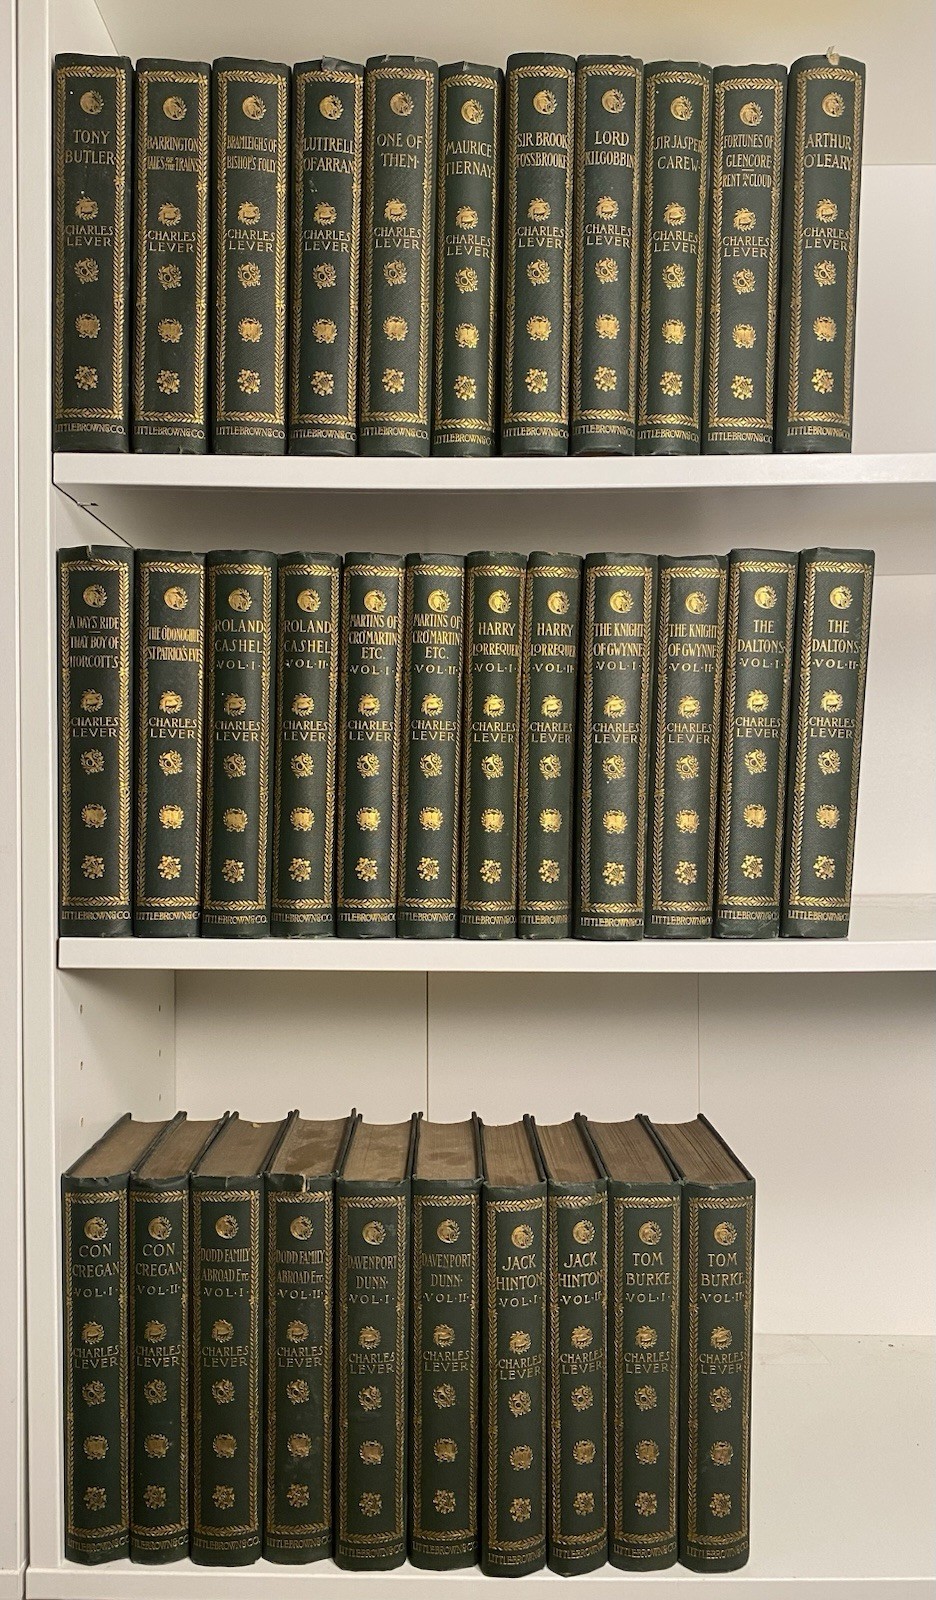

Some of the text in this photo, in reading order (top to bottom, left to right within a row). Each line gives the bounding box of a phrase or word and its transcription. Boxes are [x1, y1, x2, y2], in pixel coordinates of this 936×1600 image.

[73, 130, 110, 144] TONY
[377, 132, 423, 150] ONE OF
[517, 132, 568, 150] SIR BROOK
[594, 130, 630, 147] LORD
[654, 135, 671, 150] SIR
[723, 133, 774, 149] FORTUNES OF
[805, 132, 852, 150] ARTHUR
[268, 140, 278, 153] OF
[446, 140, 491, 158] MAURICE
[304, 157, 316, 171] OF
[722, 173, 771, 188] RENT CLOUD
[65, 225, 113, 236] CHARLES
[147, 230, 196, 242] CHARLES
[303, 230, 350, 242] CHARLES
[374, 226, 421, 239] CHARLES
[517, 226, 564, 238] CHARLES
[585, 224, 631, 237] CHARLES
[652, 230, 698, 244] CHARLES
[803, 227, 849, 240] CHARLES
[67, 237, 111, 247] LEVER
[149, 242, 194, 253] LEVER
[304, 241, 349, 253] LEVER
[375, 238, 420, 250] LEVER
[518, 237, 563, 249] LEVER
[586, 235, 631, 249] LEVER
[654, 241, 697, 255] LEVER
[805, 238, 848, 251] LEVER
[70, 616, 76, 629] A
[100, 616, 120, 630] RIDE
[214, 619, 264, 634] ROLAND
[284, 619, 331, 634] ROLAND
[350, 614, 399, 629] MARTINS OF
[413, 614, 461, 629] MARTINS OF
[753, 619, 775, 634] THE
[828, 619, 850, 634] THE
[149, 627, 161, 640] THE
[478, 622, 516, 637] HARRY
[537, 622, 574, 637] HARRY
[594, 623, 644, 637] THE KNIGHT
[670, 623, 718, 639] THE KNIGHT
[70, 635, 120, 650] THAT BOY OF
[214, 639, 263, 654] CASHEL
[284, 639, 331, 654] CASHEL
[593, 642, 643, 657] OF GWYNNE
[189, 648, 200, 662] EVE
[361, 647, 386, 659] ETC.
[425, 647, 449, 660] ETC.
[668, 643, 717, 658] OF GWYNNE
[71, 716, 119, 727] CHARLES
[149, 717, 197, 728] CHARLES
[283, 720, 328, 731] CHARLES
[347, 720, 394, 731] CHARLES
[472, 722, 516, 732] CHARLES
[593, 723, 640, 733] CHARLES
[667, 723, 712, 733] CHARLES
[736, 717, 780, 728] CHARLES
[810, 717, 855, 728] CHARLES
[72, 728, 118, 738] LEVER
[150, 728, 196, 739] LEVER
[284, 732, 327, 742] LEVER
[350, 731, 392, 741] LEVER
[474, 732, 514, 743] LEVER
[594, 733, 638, 744] LEVER
[668, 733, 711, 744] LEVER
[737, 728, 779, 739] LEVER
[810, 727, 853, 739] LEVER
[79, 1243, 112, 1258] CON
[143, 1243, 175, 1257] CON
[201, 1248, 250, 1262] DODD FAMILY
[299, 1250, 325, 1264] FAMILY
[347, 1255, 397, 1270] DAVENPORT
[421, 1253, 471, 1268] DAVENPORT
[502, 1253, 537, 1271] JACK
[563, 1251, 597, 1268] JACK
[632, 1252, 663, 1267] TOM
[708, 1252, 737, 1267] TOM
[72, 1261, 120, 1278] CREGAN
[135, 1261, 182, 1277] CREGAN
[202, 1269, 235, 1282] ABROAD
[278, 1270, 310, 1284] ABROAD
[496, 1272, 543, 1291] HINTON
[558, 1270, 603, 1288] HINTON
[626, 1272, 671, 1286] BURKE
[701, 1272, 745, 1287] BURKE
[73, 1345, 119, 1358] CHARLES
[202, 1345, 249, 1357] CHARLES
[349, 1351, 395, 1363] CHARLES
[624, 1351, 670, 1363] CHARLES
[700, 1351, 744, 1363] CHARLES
[75, 1356, 119, 1369] LEVER
[203, 1357, 247, 1368] LEVER
[498, 1354, 542, 1369] CHARLES
[625, 1363, 669, 1374] LEVER
[350, 1363, 394, 1375] LEVER
[500, 1366, 540, 1380] LEVER
[701, 1363, 742, 1375] LEVER
